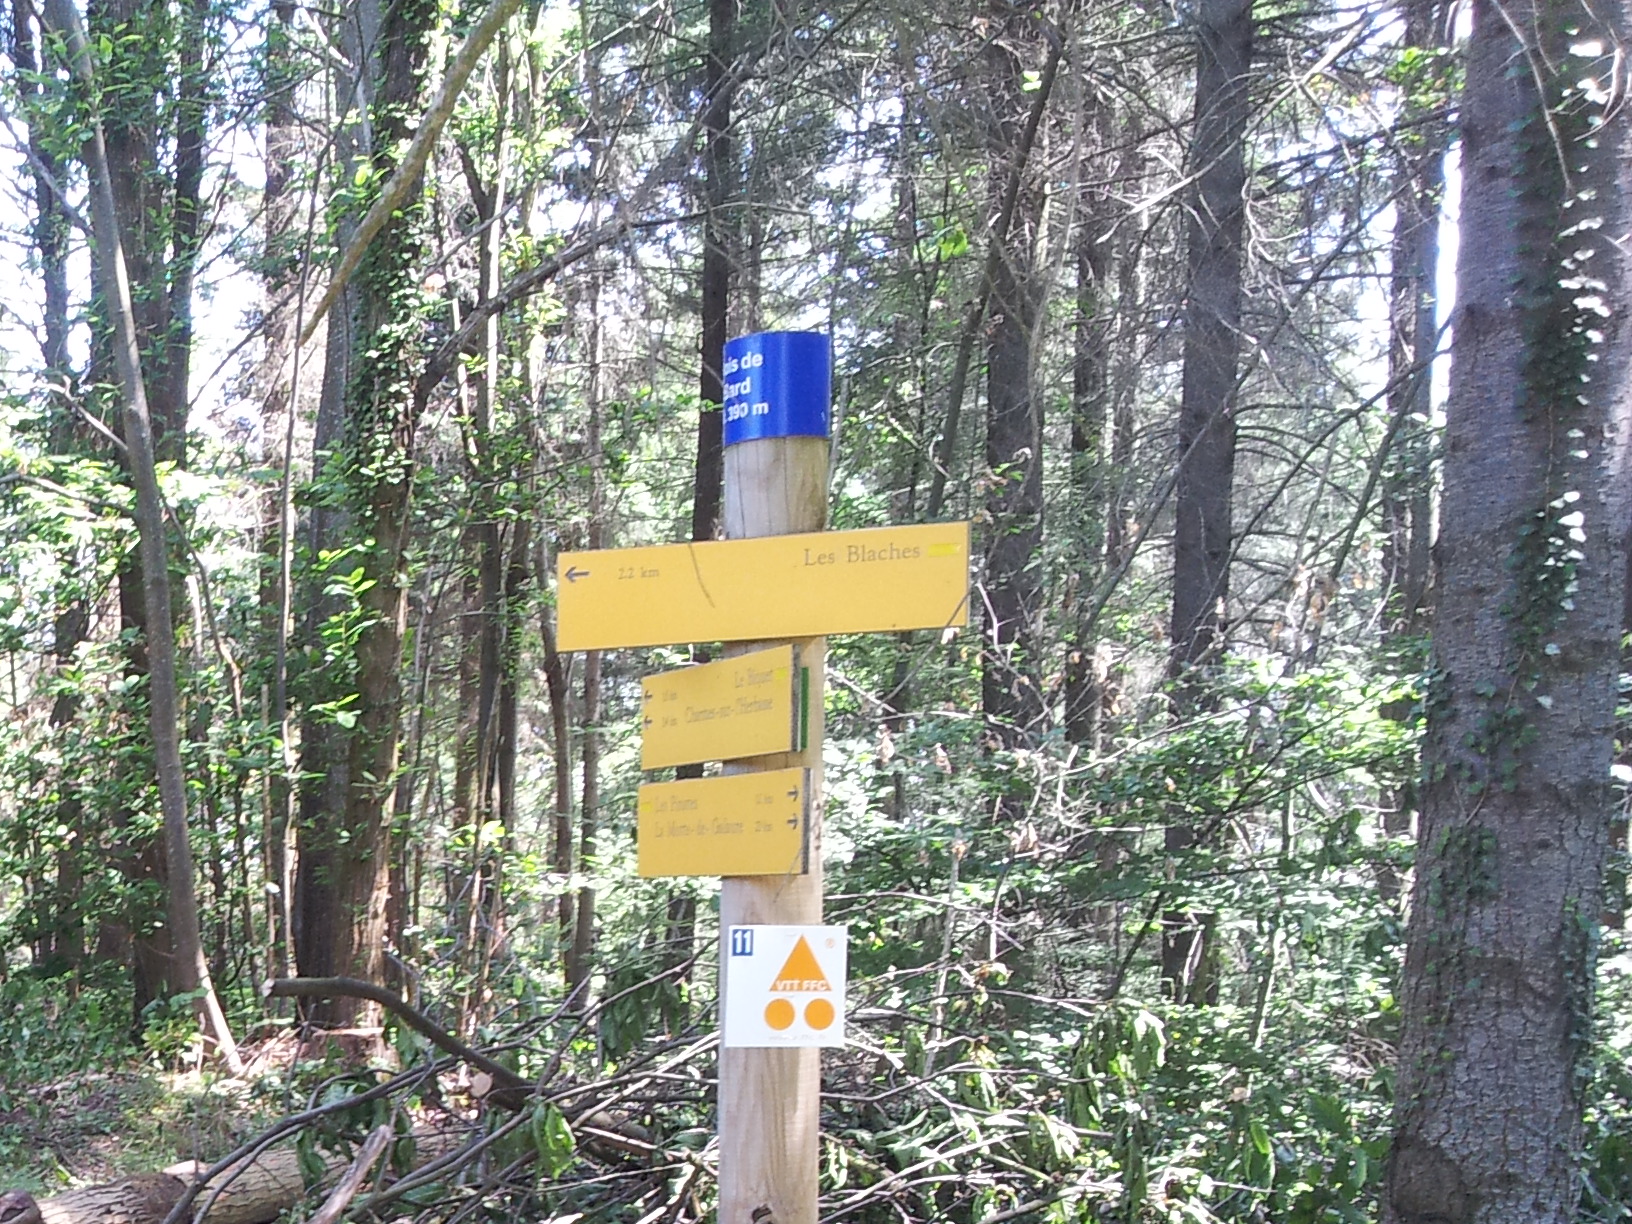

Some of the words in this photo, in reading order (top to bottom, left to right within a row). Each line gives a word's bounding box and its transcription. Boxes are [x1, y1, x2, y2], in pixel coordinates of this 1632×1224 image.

[741, 351, 764, 369] de
[752, 402, 769, 417] m
[804, 547, 836, 567] Les
[846, 541, 921, 564] Blaches
[734, 930, 752, 955] 11
[775, 979, 802, 992] VTT
[802, 979, 828, 992] FFC
